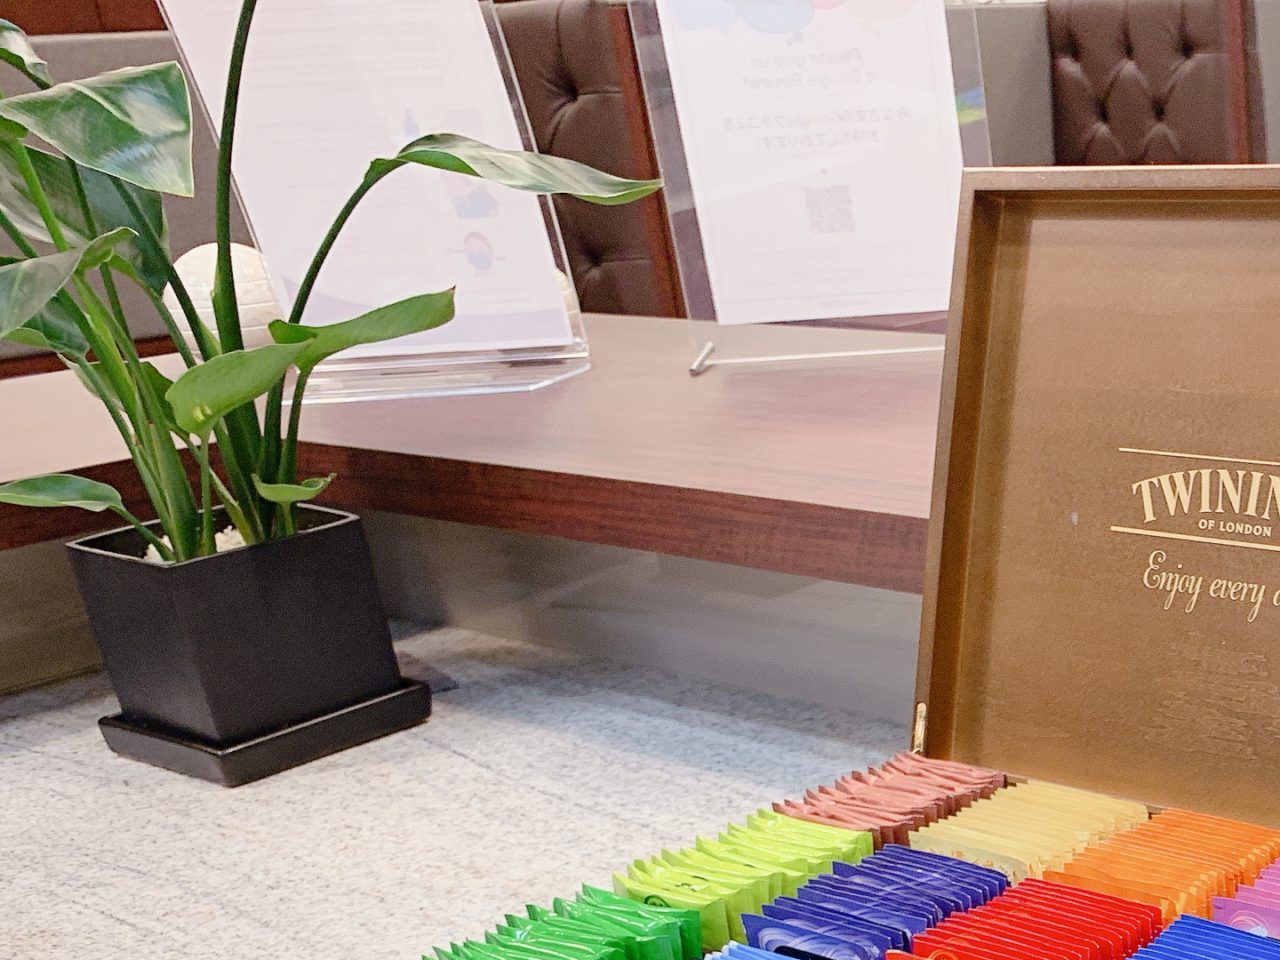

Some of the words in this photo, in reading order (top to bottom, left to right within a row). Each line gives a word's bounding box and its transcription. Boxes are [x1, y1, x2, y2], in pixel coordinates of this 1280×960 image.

[1198, 518, 1215, 531] OF
[1219, 520, 1272, 537] LONDON
[1143, 550, 1203, 613] Enjoy
[1208, 578, 1266, 622] every
